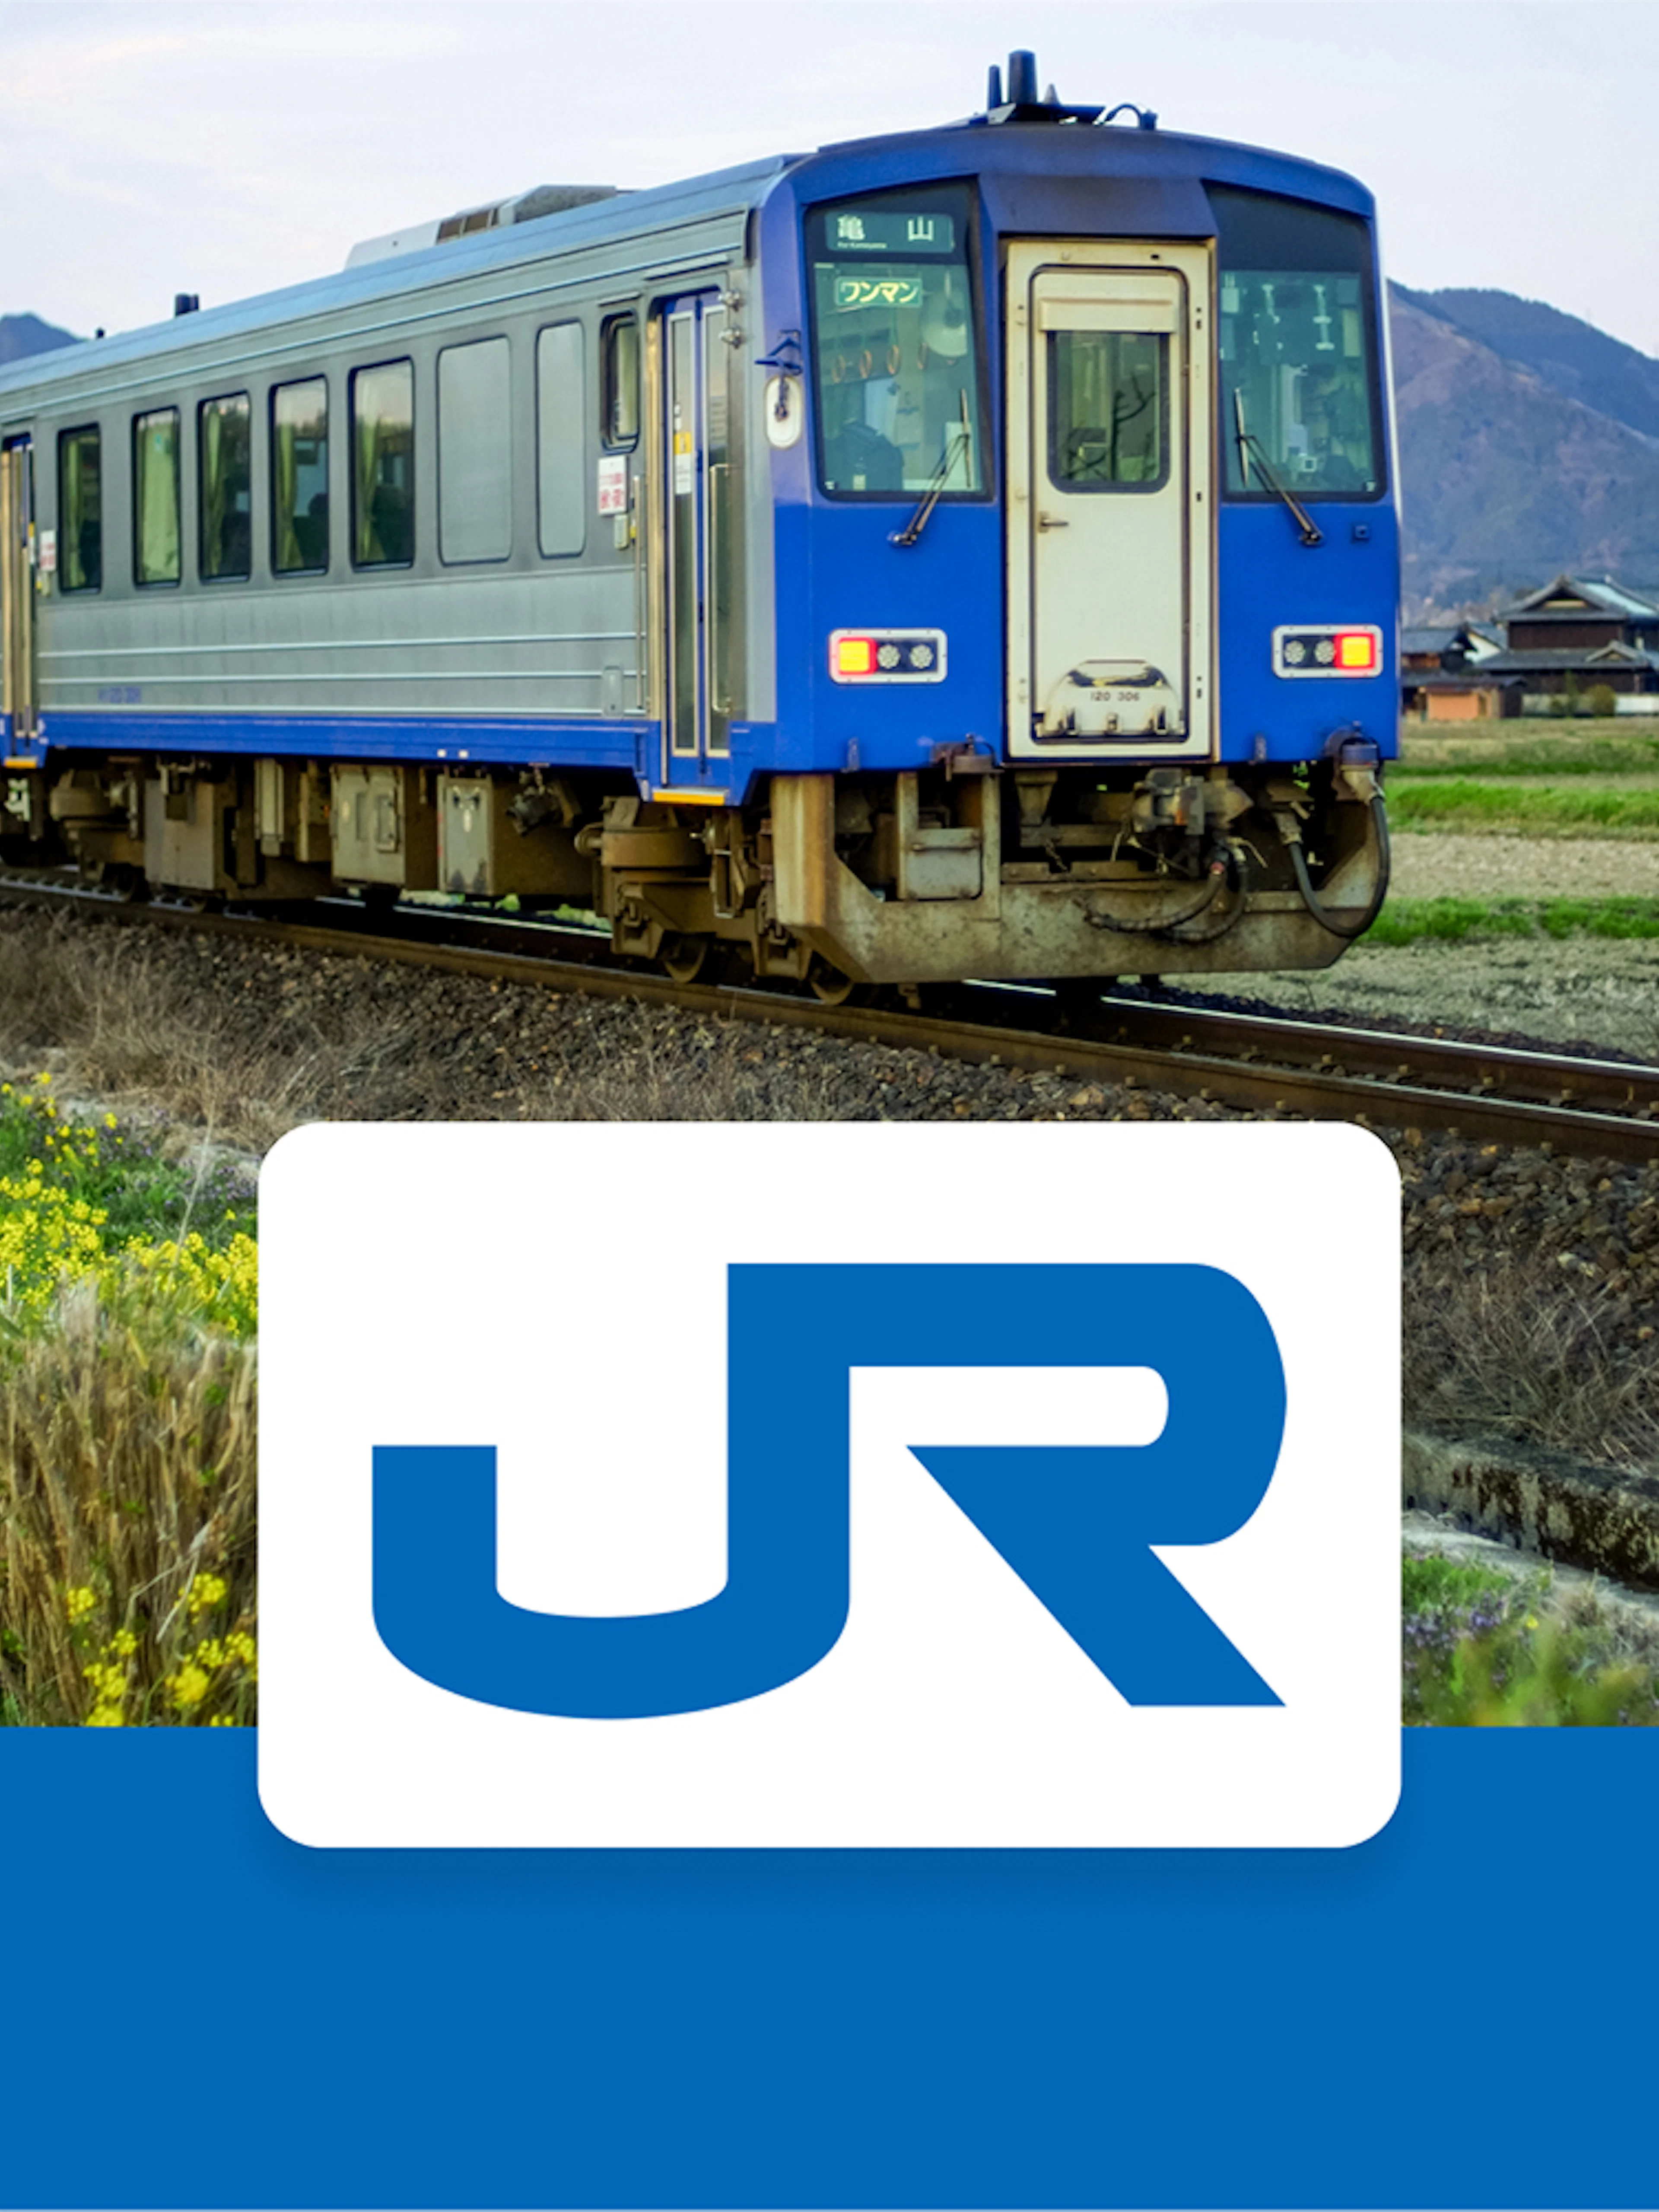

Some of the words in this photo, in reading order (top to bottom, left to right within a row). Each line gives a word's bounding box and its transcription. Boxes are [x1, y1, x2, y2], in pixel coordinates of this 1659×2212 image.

[840, 281, 919, 302] ワンマン
[1090, 691, 1111, 702] 120
[1117, 691, 1140, 702] 306
